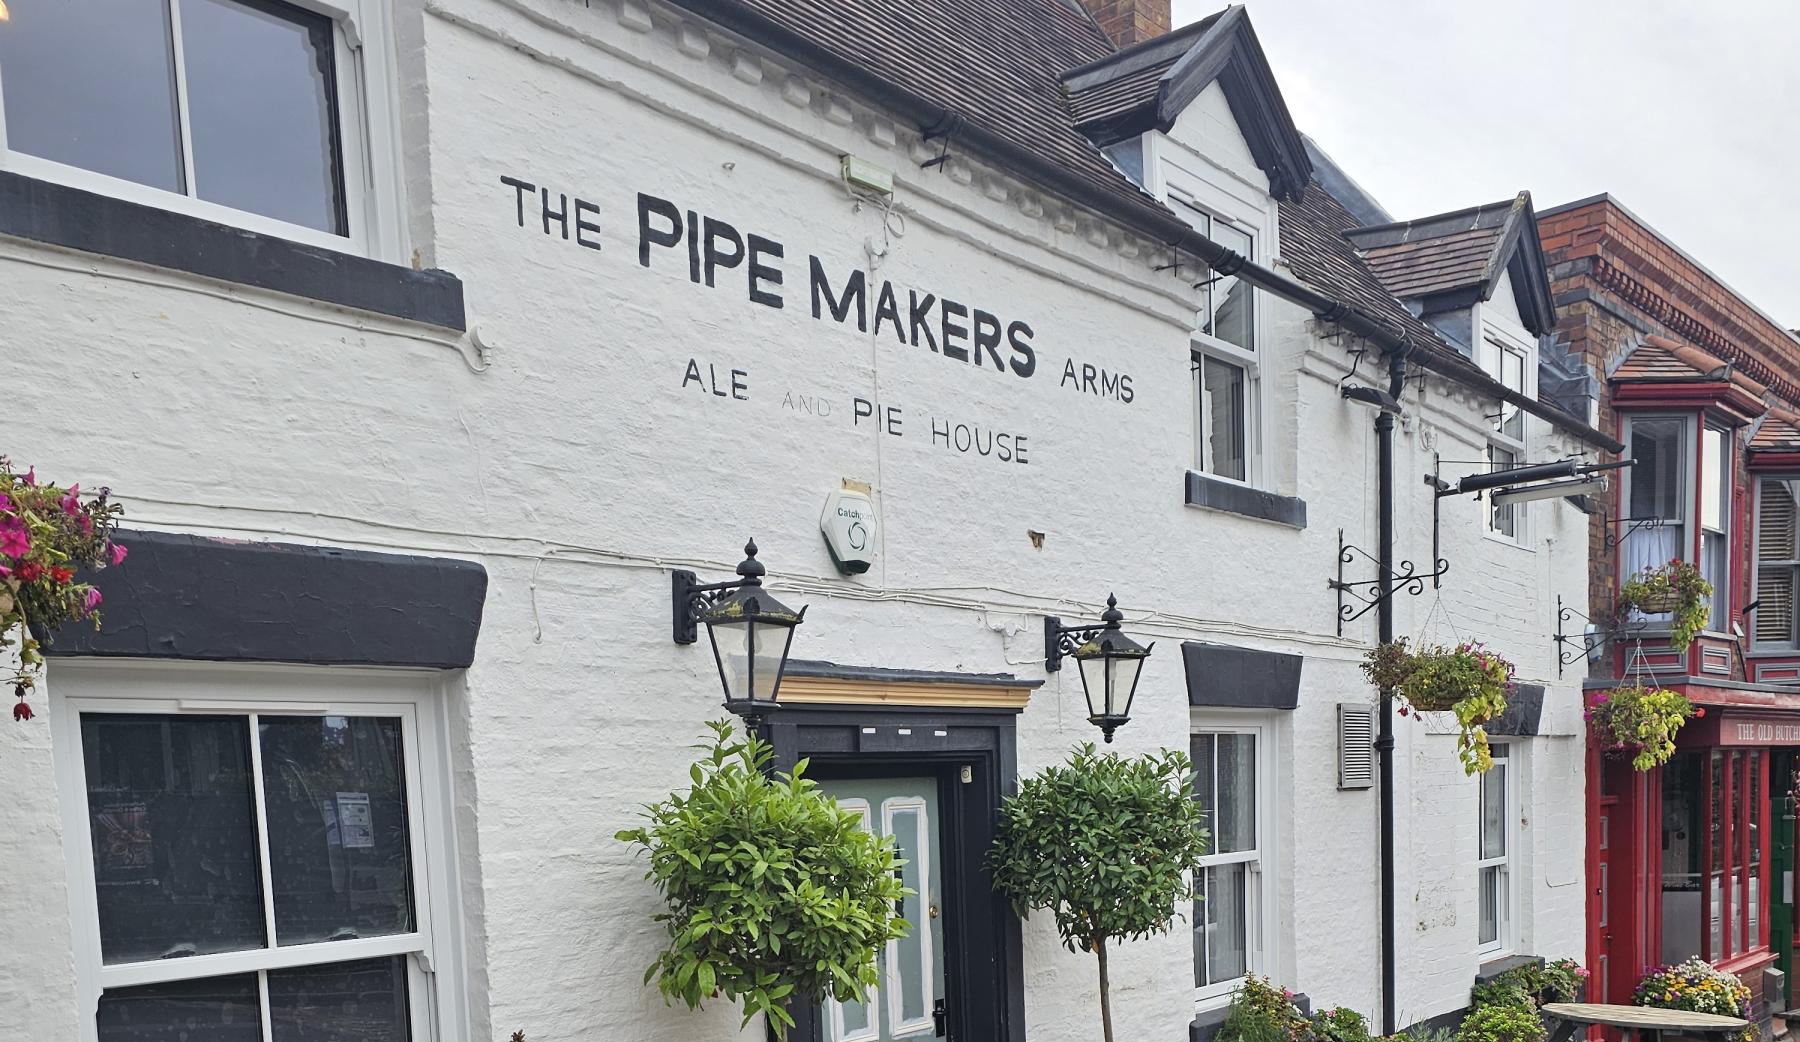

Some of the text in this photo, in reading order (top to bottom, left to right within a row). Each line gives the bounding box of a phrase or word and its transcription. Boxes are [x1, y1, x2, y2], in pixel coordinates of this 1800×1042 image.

[501, 175, 1134, 404] THE PIPE MAKERS ARMS
[682, 358, 1029, 465] ALE AND PIE HOUSE
[1736, 723, 1755, 741] THE
[1757, 724, 1773, 741] OLD
